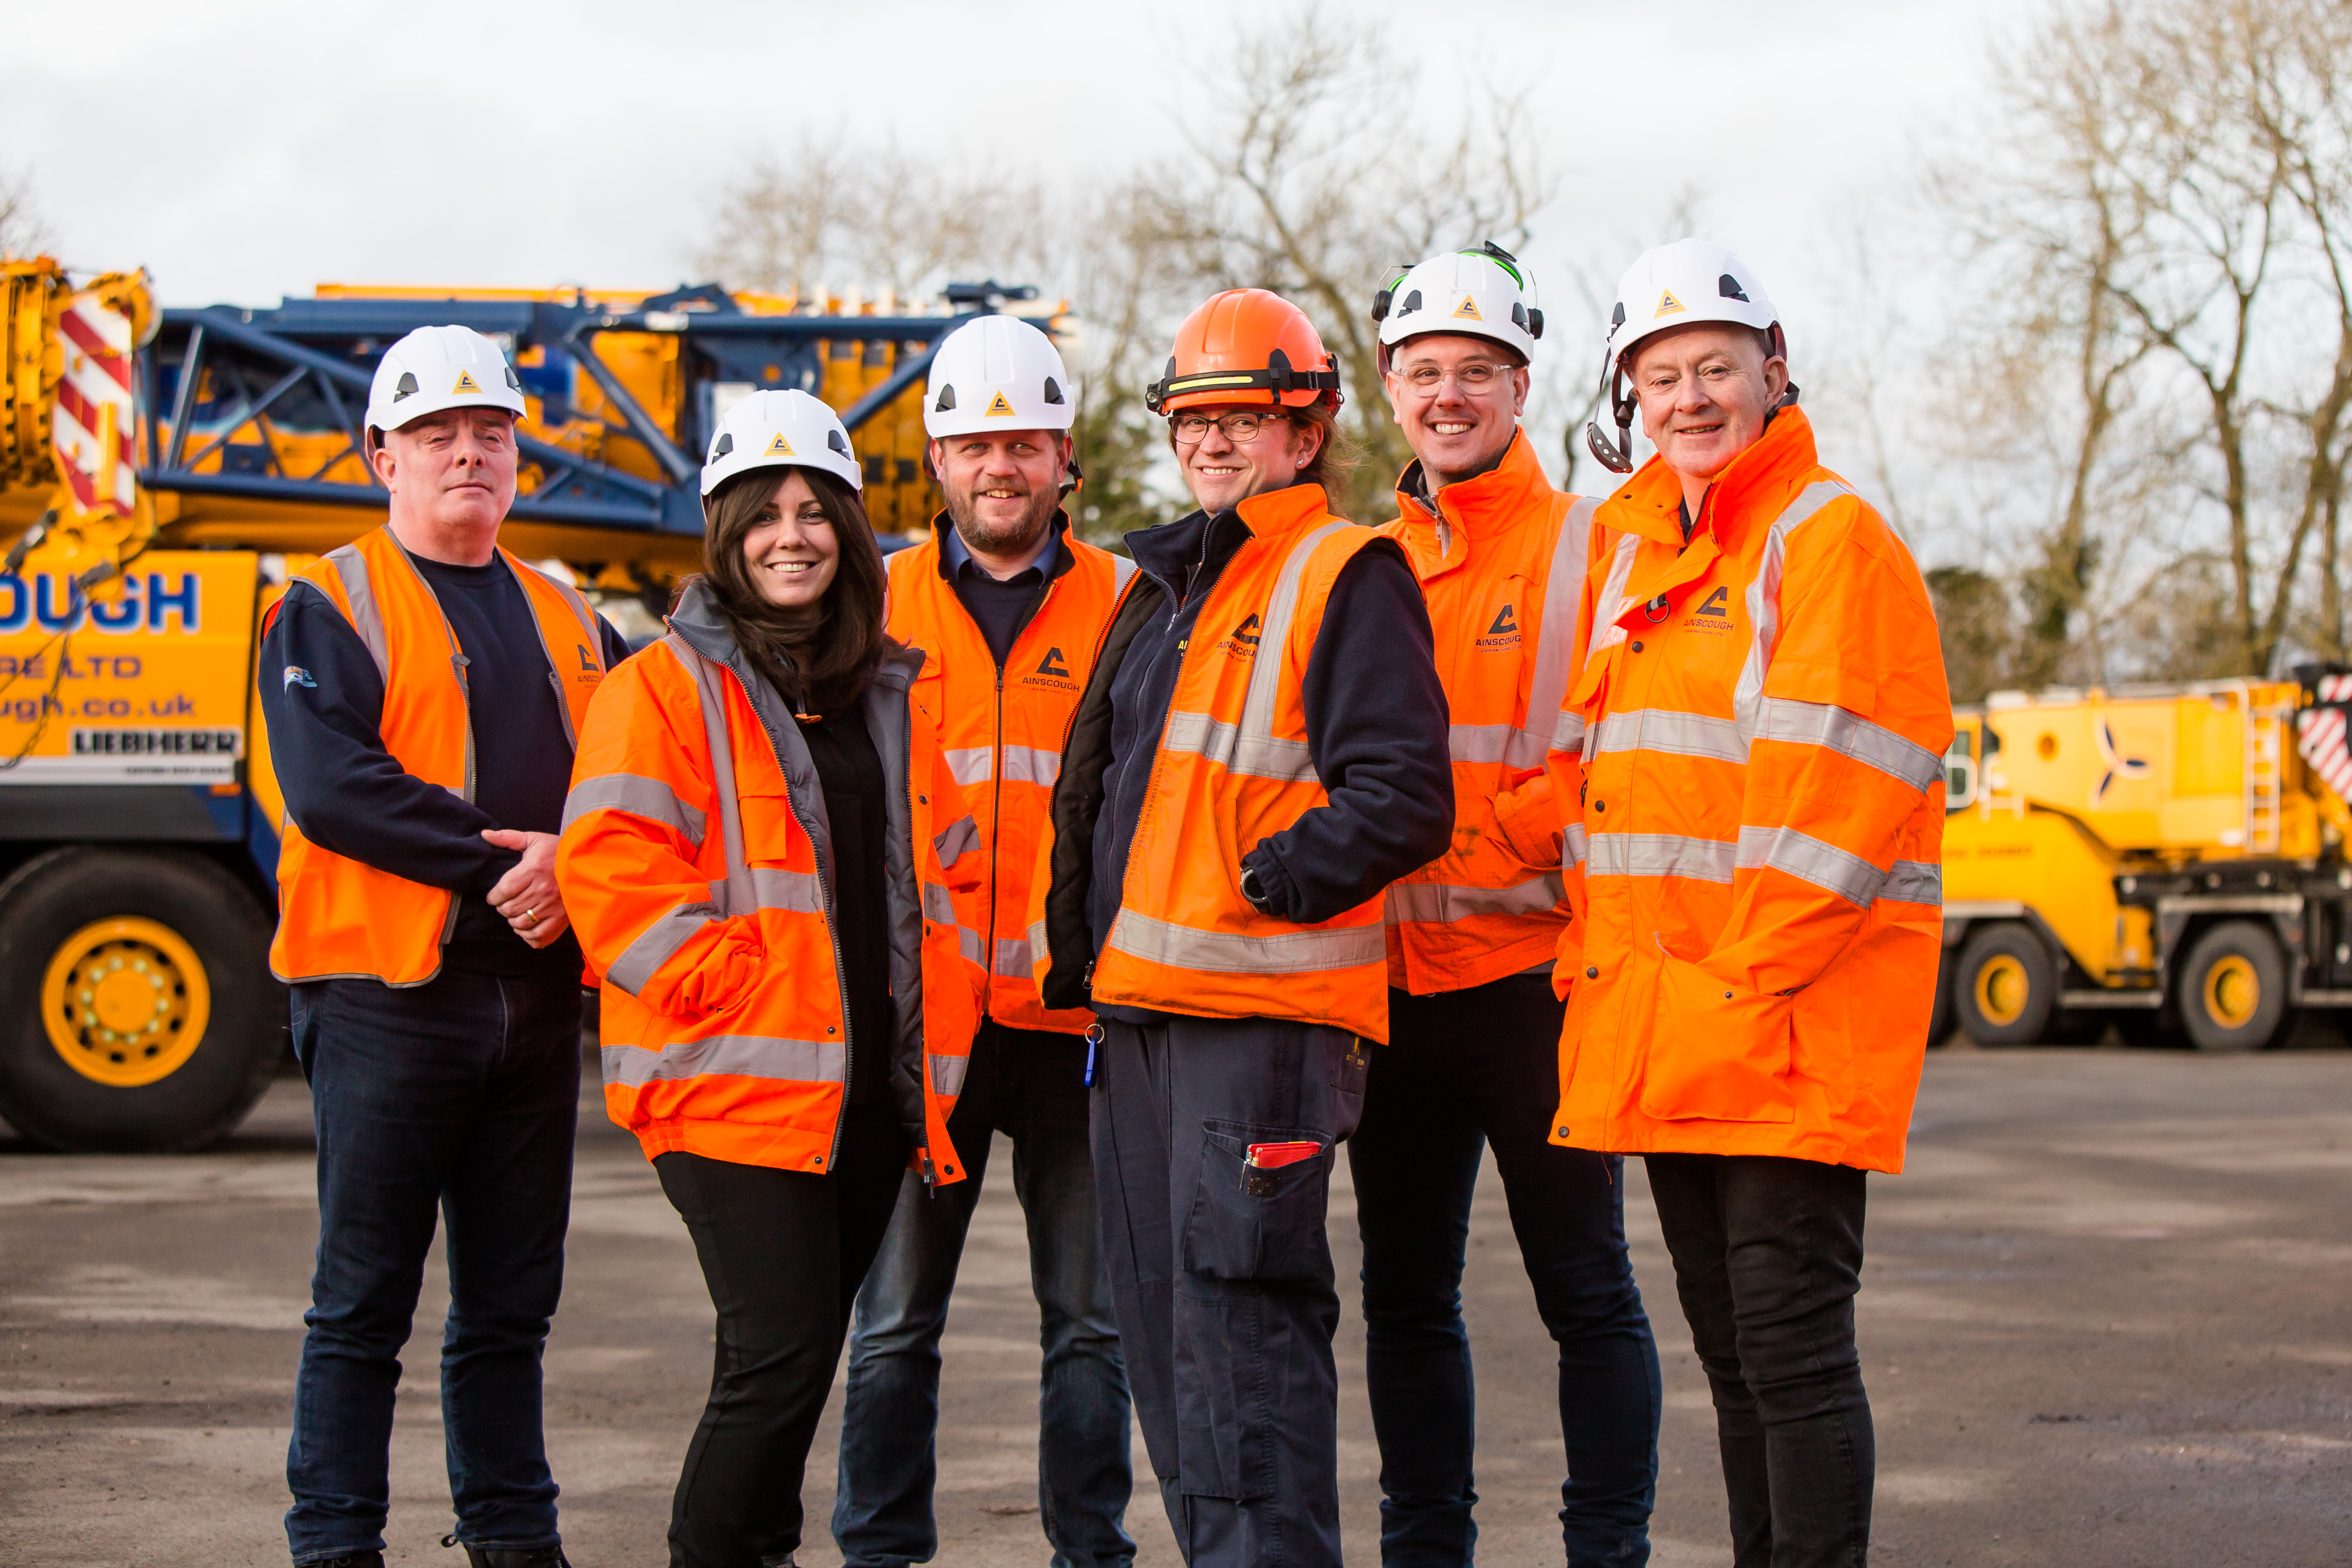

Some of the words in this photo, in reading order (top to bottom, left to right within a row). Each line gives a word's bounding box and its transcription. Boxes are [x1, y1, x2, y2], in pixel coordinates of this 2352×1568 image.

[1683, 619, 1734, 631] AINSCOUGH
[1476, 635, 1521, 646] AINSCOUG
[63, 655, 142, 679] LTD
[1022, 677, 1080, 692] AINSCOUGH
